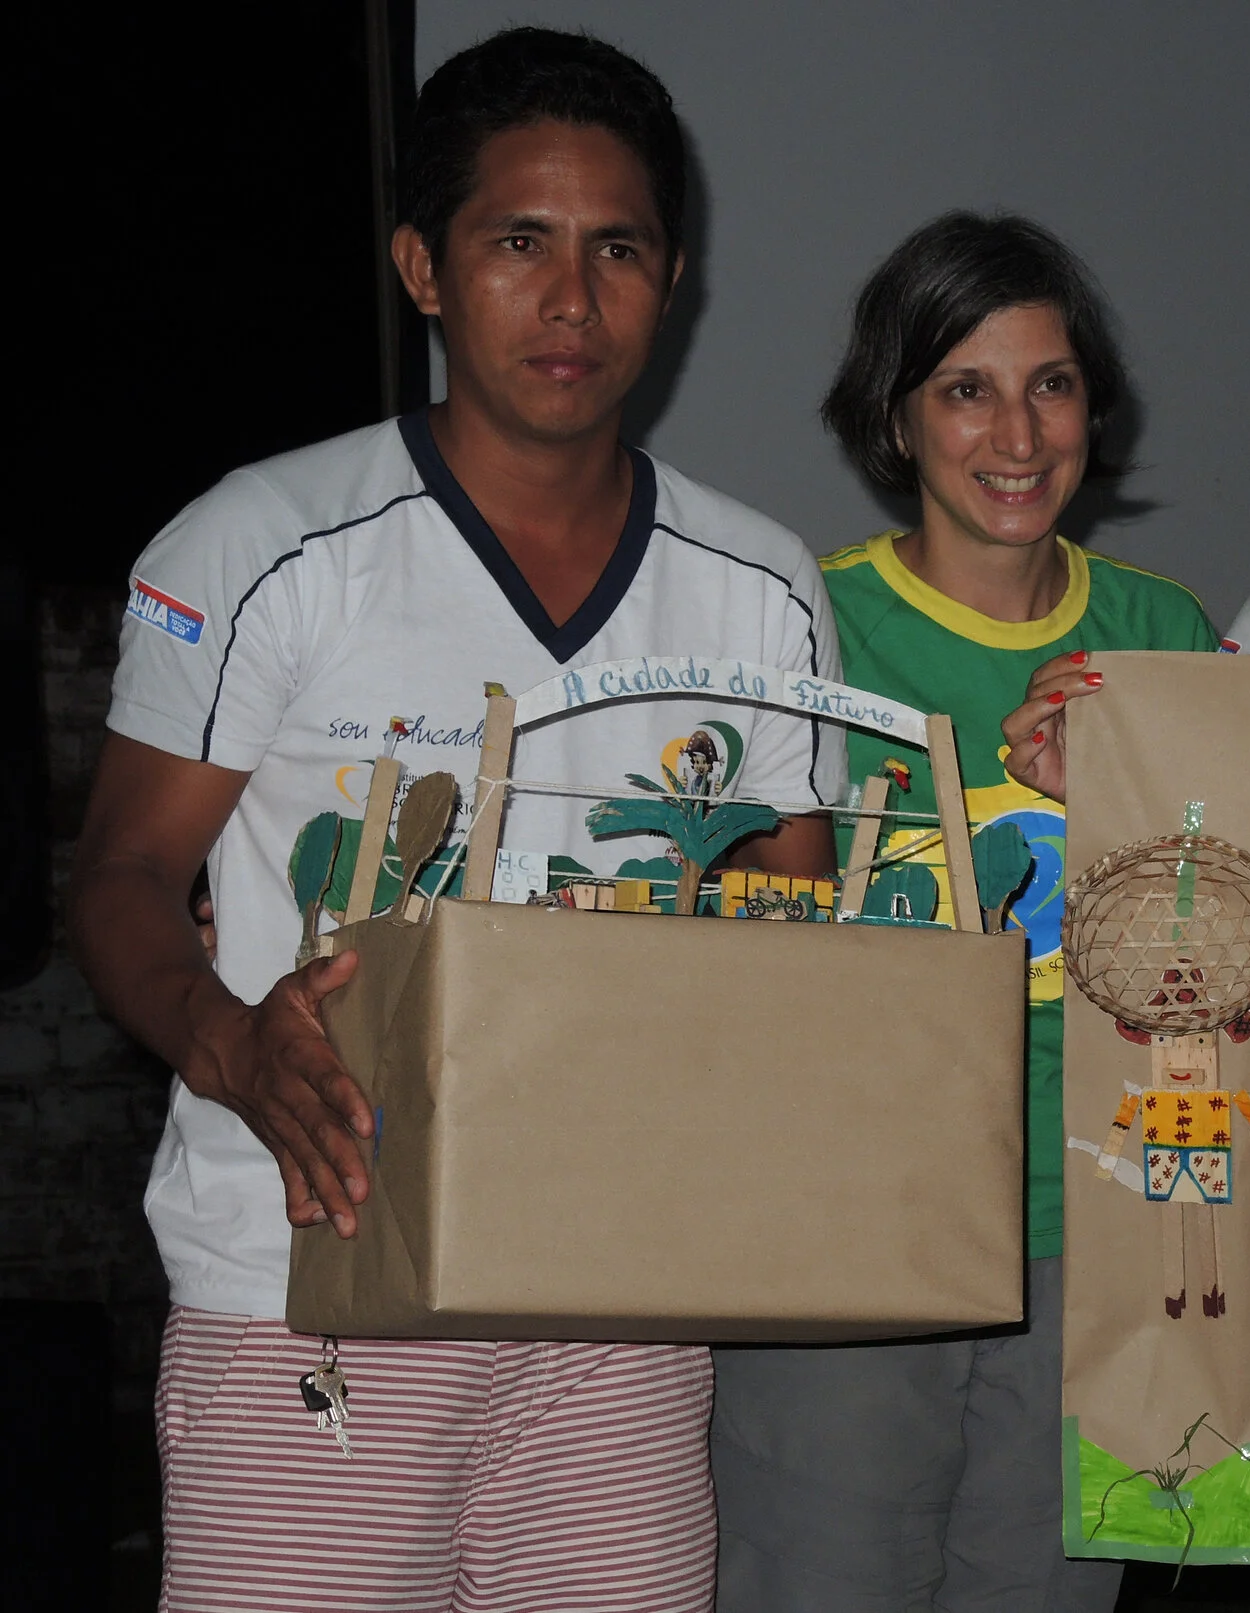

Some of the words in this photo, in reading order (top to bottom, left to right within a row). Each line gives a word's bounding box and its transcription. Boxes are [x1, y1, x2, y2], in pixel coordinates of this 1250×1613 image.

[127, 589, 168, 630] AHIA
[562, 670, 586, 708] A
[789, 679, 894, 729] Futuro
[328, 717, 369, 740] sou
